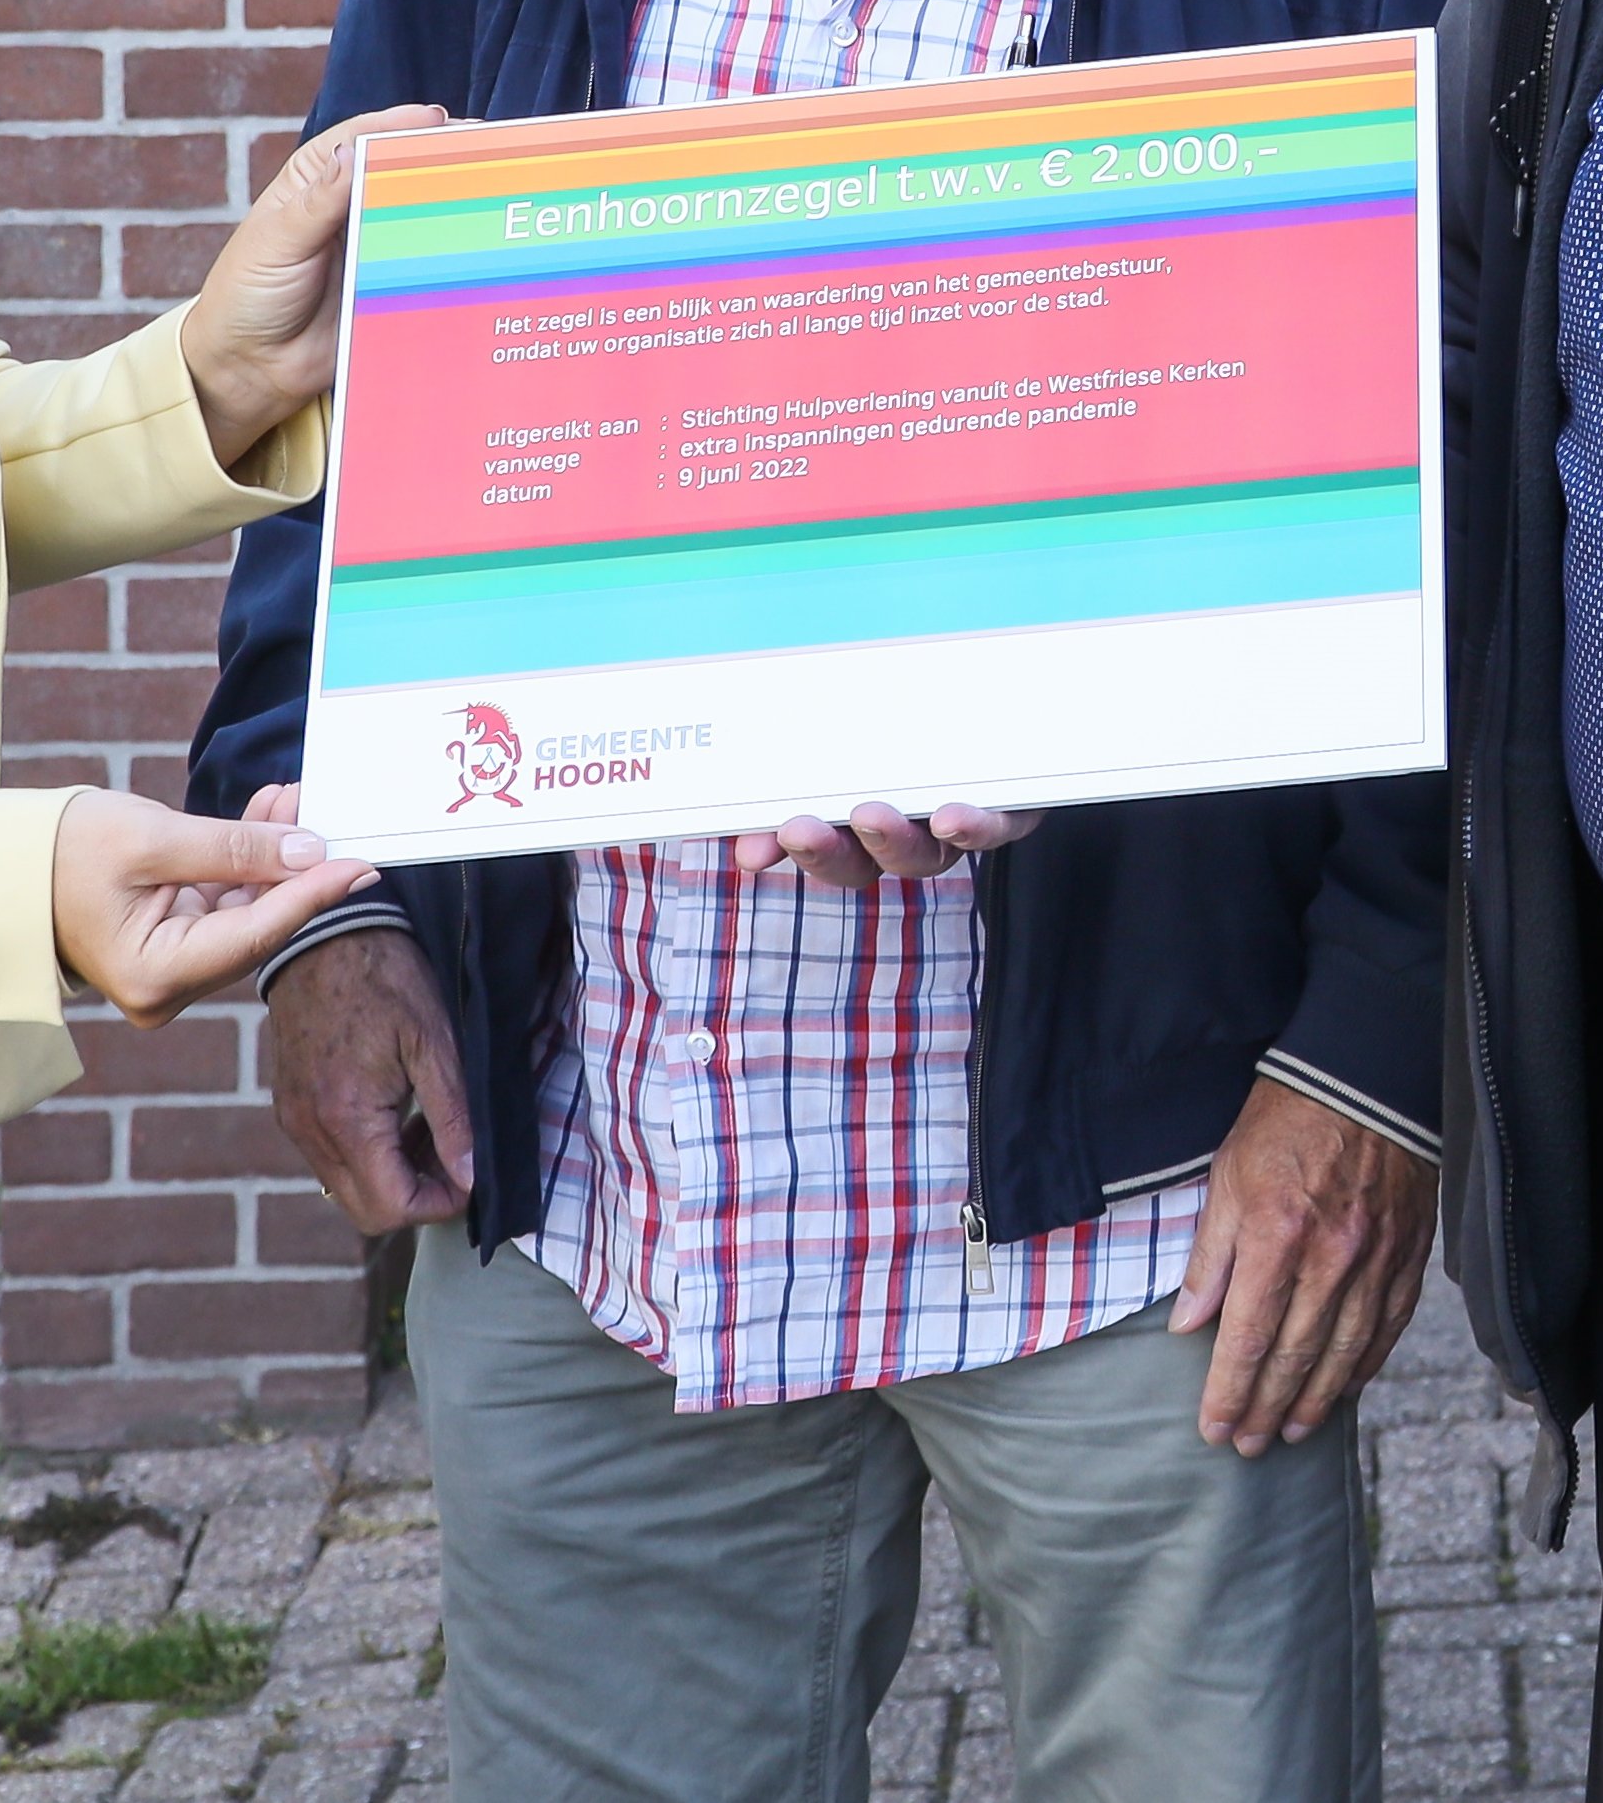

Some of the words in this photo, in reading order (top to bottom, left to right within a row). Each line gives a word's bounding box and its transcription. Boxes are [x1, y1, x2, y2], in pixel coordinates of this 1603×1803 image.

[504, 164, 878, 241] Eenhoornzegel
[896, 163, 1023, 202] t.w.v.
[1039, 148, 1074, 188] €
[1091, 132, 1279, 184] 2.000,-
[492, 340, 561, 364] omdat
[567, 338, 598, 357] uw
[604, 324, 724, 356] organisatie
[730, 321, 772, 342] zich
[779, 315, 798, 336] al
[804, 310, 863, 335] lange
[869, 306, 904, 330] tijd
[910, 300, 963, 323] inzet
[969, 298, 1017, 318] voor
[1023, 292, 1051, 314] de
[1056, 286, 1110, 310] stad.
[494, 315, 533, 336] Het
[537, 307, 593, 334] zegel
[599, 306, 617, 326] is
[623, 305, 662, 324] een
[668, 297, 713, 322] blijk
[718, 296, 757, 315] van
[763, 281, 884, 310] waardering
[890, 279, 929, 299] van
[935, 273, 970, 294] het
[976, 255, 1173, 293] gemeentebestuur,
[484, 452, 581, 477] vanwege
[680, 436, 737, 459] extra
[744, 421, 894, 454] inspanningen
[900, 409, 1021, 441] gedurende
[1027, 398, 1137, 429] pandemie
[486, 421, 592, 449] uitgereikt
[599, 418, 640, 438] aan
[681, 402, 779, 430] Stichting
[784, 389, 935, 420] Hulpverlening
[941, 379, 1009, 405] vanuit
[1014, 376, 1042, 397] de
[1046, 367, 1163, 395] Westfriese
[1169, 359, 1246, 383] Kerken
[482, 481, 553, 506] datum
[678, 468, 694, 489] 9
[697, 463, 741, 490] juni
[750, 456, 809, 481] 2022
[534, 757, 652, 791] HOORN
[536, 723, 713, 762] GEMEENTE
